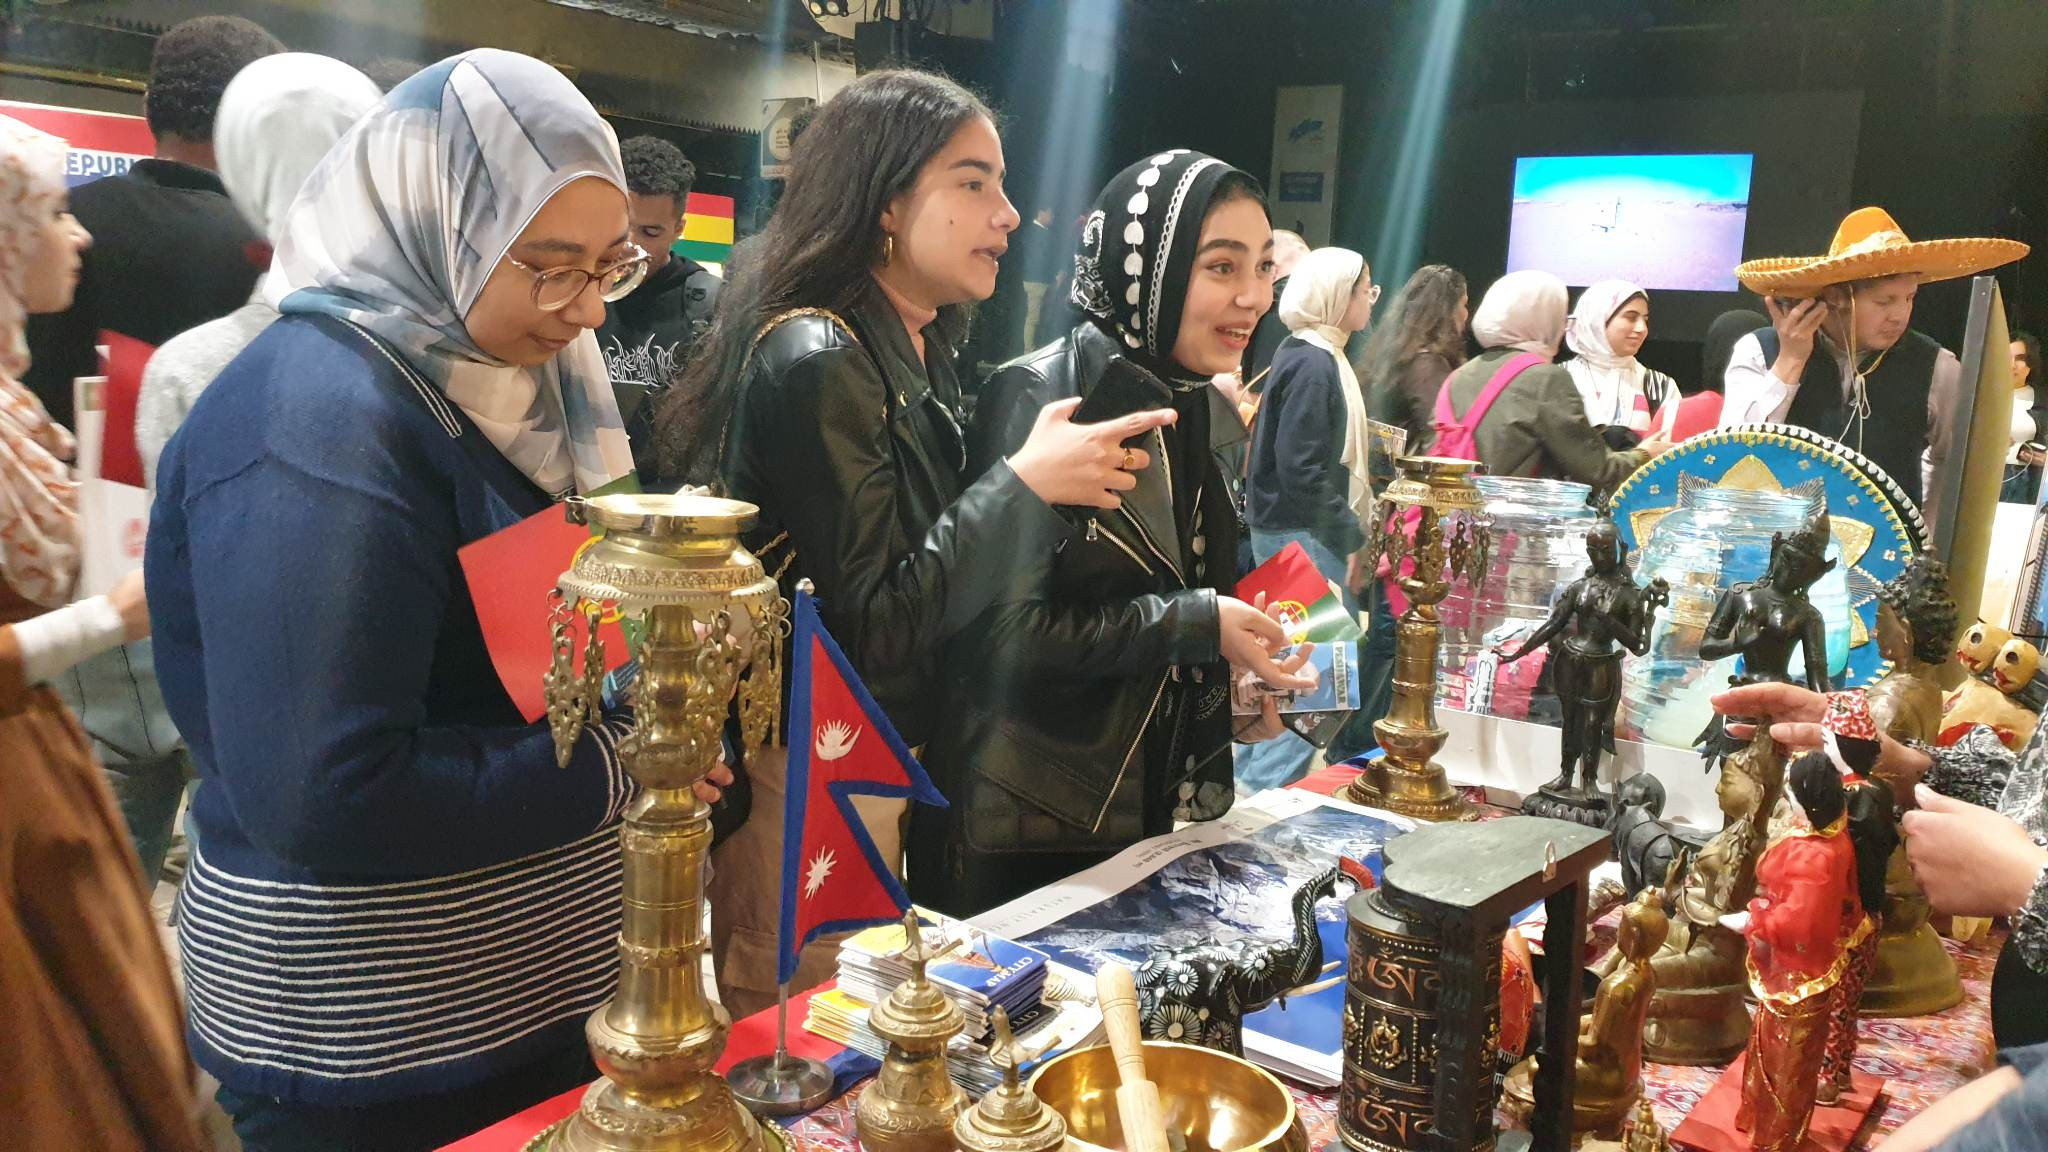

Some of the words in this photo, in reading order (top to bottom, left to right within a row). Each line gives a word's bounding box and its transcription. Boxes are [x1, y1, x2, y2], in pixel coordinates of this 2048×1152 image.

[66, 152, 135, 175] EPUB
[1008, 956, 1033, 974] CITY
[985, 970, 1012, 987] MAP
